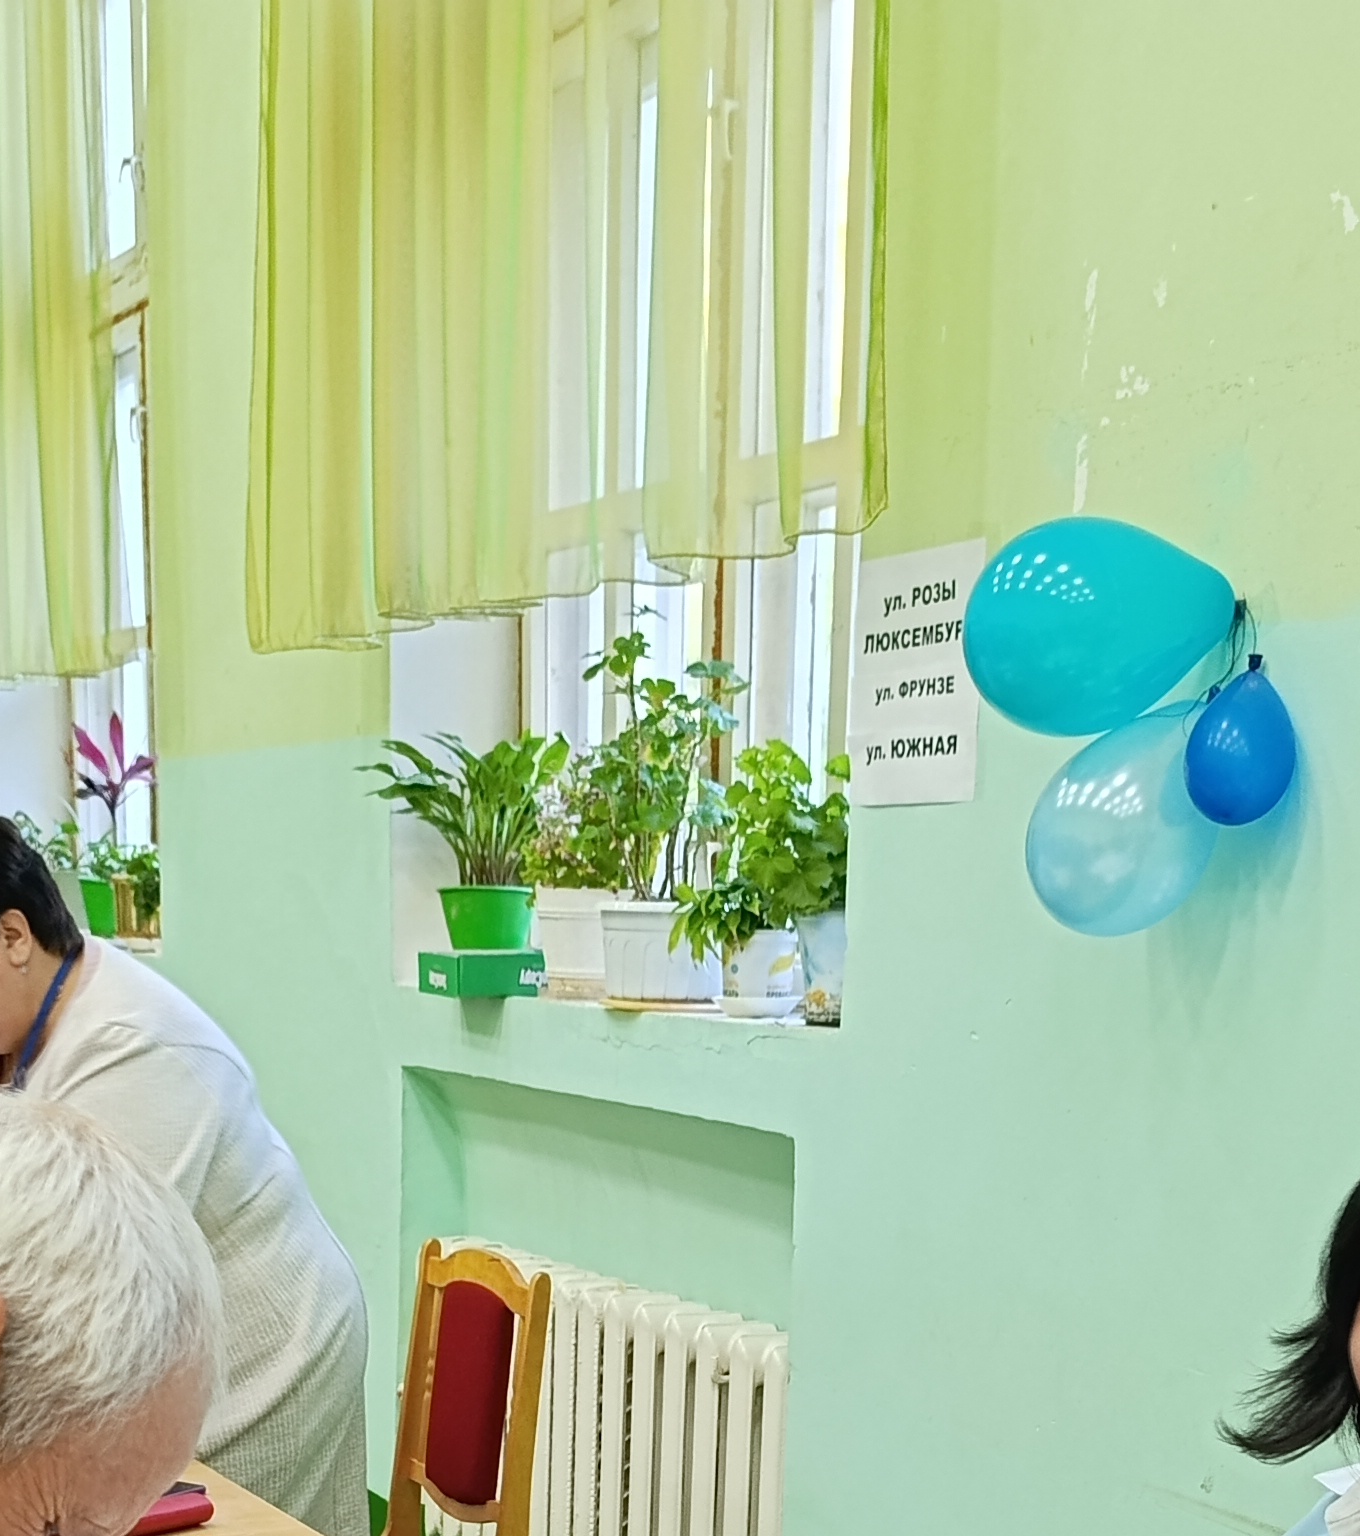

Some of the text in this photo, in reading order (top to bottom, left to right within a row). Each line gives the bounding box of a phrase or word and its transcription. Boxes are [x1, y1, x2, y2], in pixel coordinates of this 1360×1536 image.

[884, 579, 956, 617] ул. РОЗЫ
[875, 675, 955, 706] ул. ФРУНЗЕ
[867, 734, 958, 766] ул. ЮЖНАЯ
